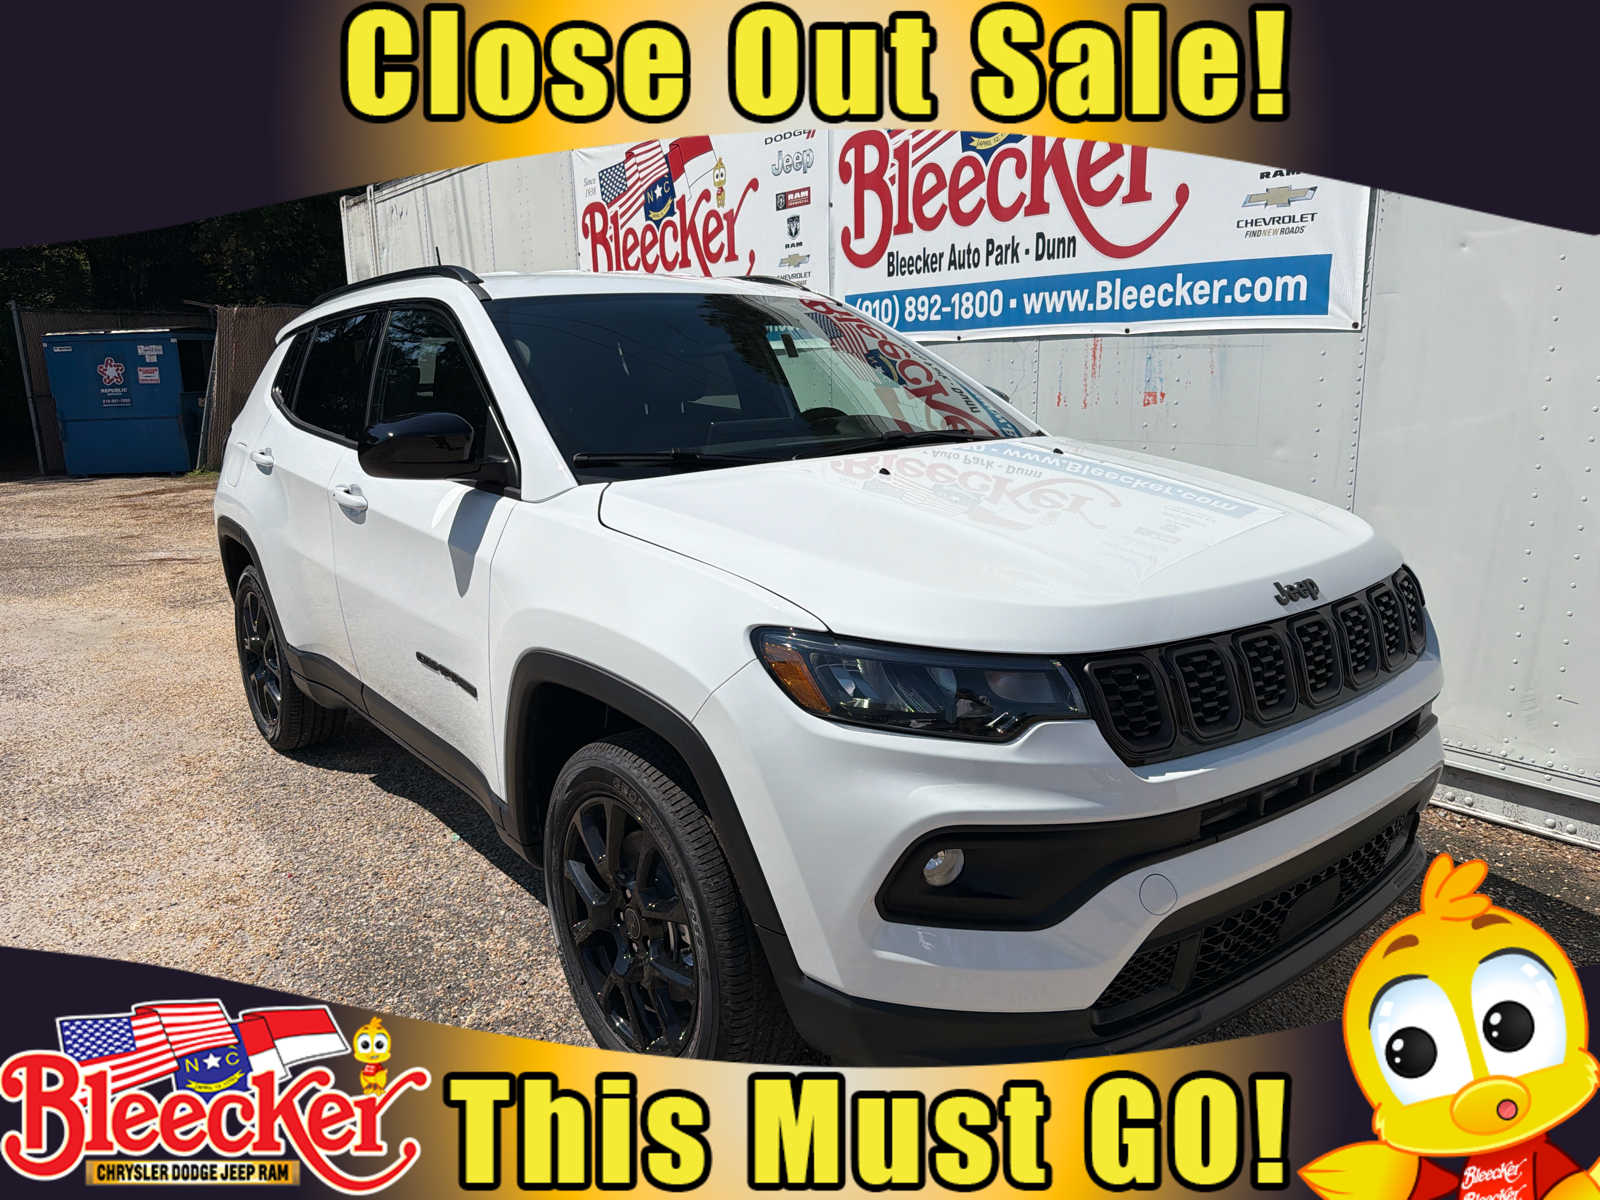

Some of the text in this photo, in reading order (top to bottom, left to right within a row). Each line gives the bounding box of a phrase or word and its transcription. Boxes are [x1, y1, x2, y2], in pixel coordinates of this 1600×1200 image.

[771, 148, 814, 177] Jeep
[788, 191, 809, 201] RAM
[838, 130, 1189, 269] Bleecker
[582, 177, 759, 277] Bleecker
[1236, 212, 1318, 228] CHEVROLET
[887, 250, 944, 277] Bleecker
[948, 242, 980, 271] Auto
[984, 235, 1020, 266] Park
[1035, 232, 1077, 262] Dunn
[904, 288, 1003, 322] 892-1800
[1023, 273, 1307, 314] www.Bleecker.com
[1273, 578, 1320, 606] Jeep
